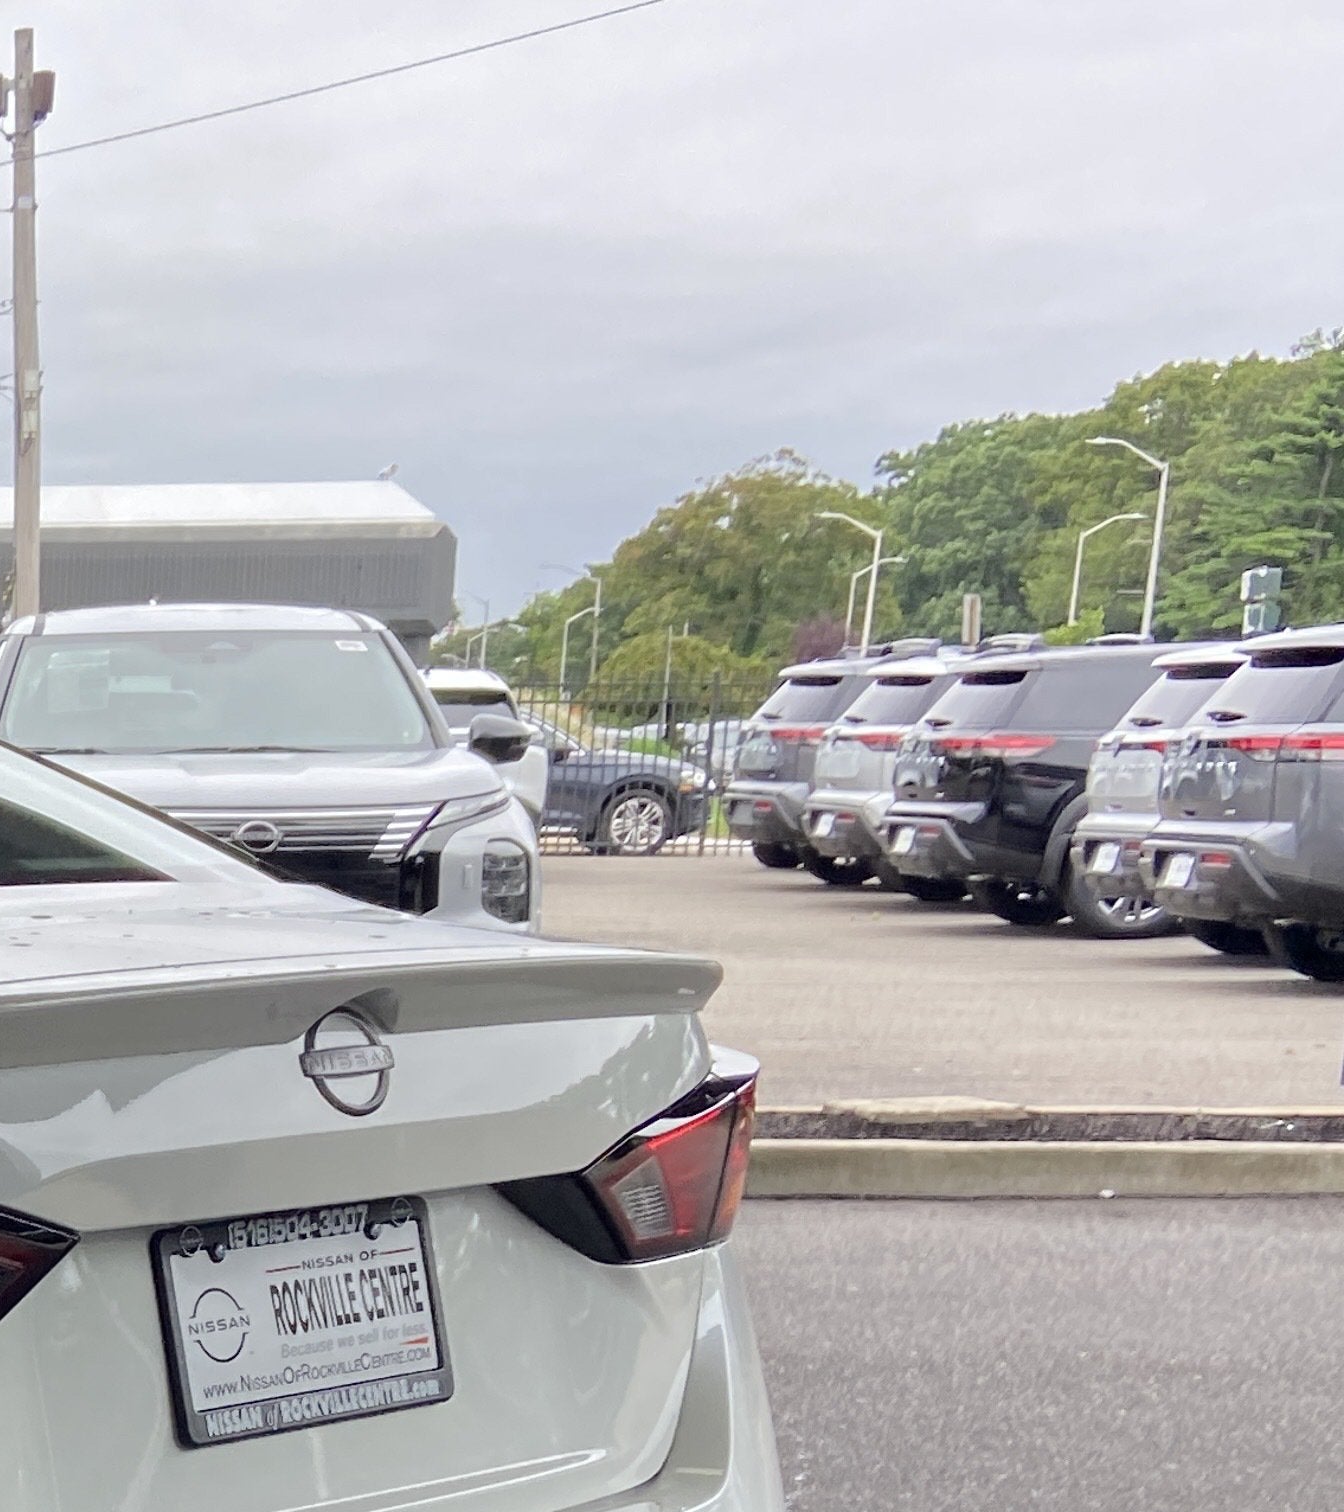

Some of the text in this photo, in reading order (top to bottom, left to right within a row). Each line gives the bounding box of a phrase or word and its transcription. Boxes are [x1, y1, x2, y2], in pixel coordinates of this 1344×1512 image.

[301, 1249, 379, 1271] NISSAN OF
[269, 1262, 424, 1336] ROCKVILLE CENTRE
[188, 1314, 251, 1336] NISSAN
[281, 1338, 334, 1359] Because
[337, 1335, 355, 1348] we
[382, 1325, 400, 1340] for
[205, 1405, 264, 1437] NISSAN
